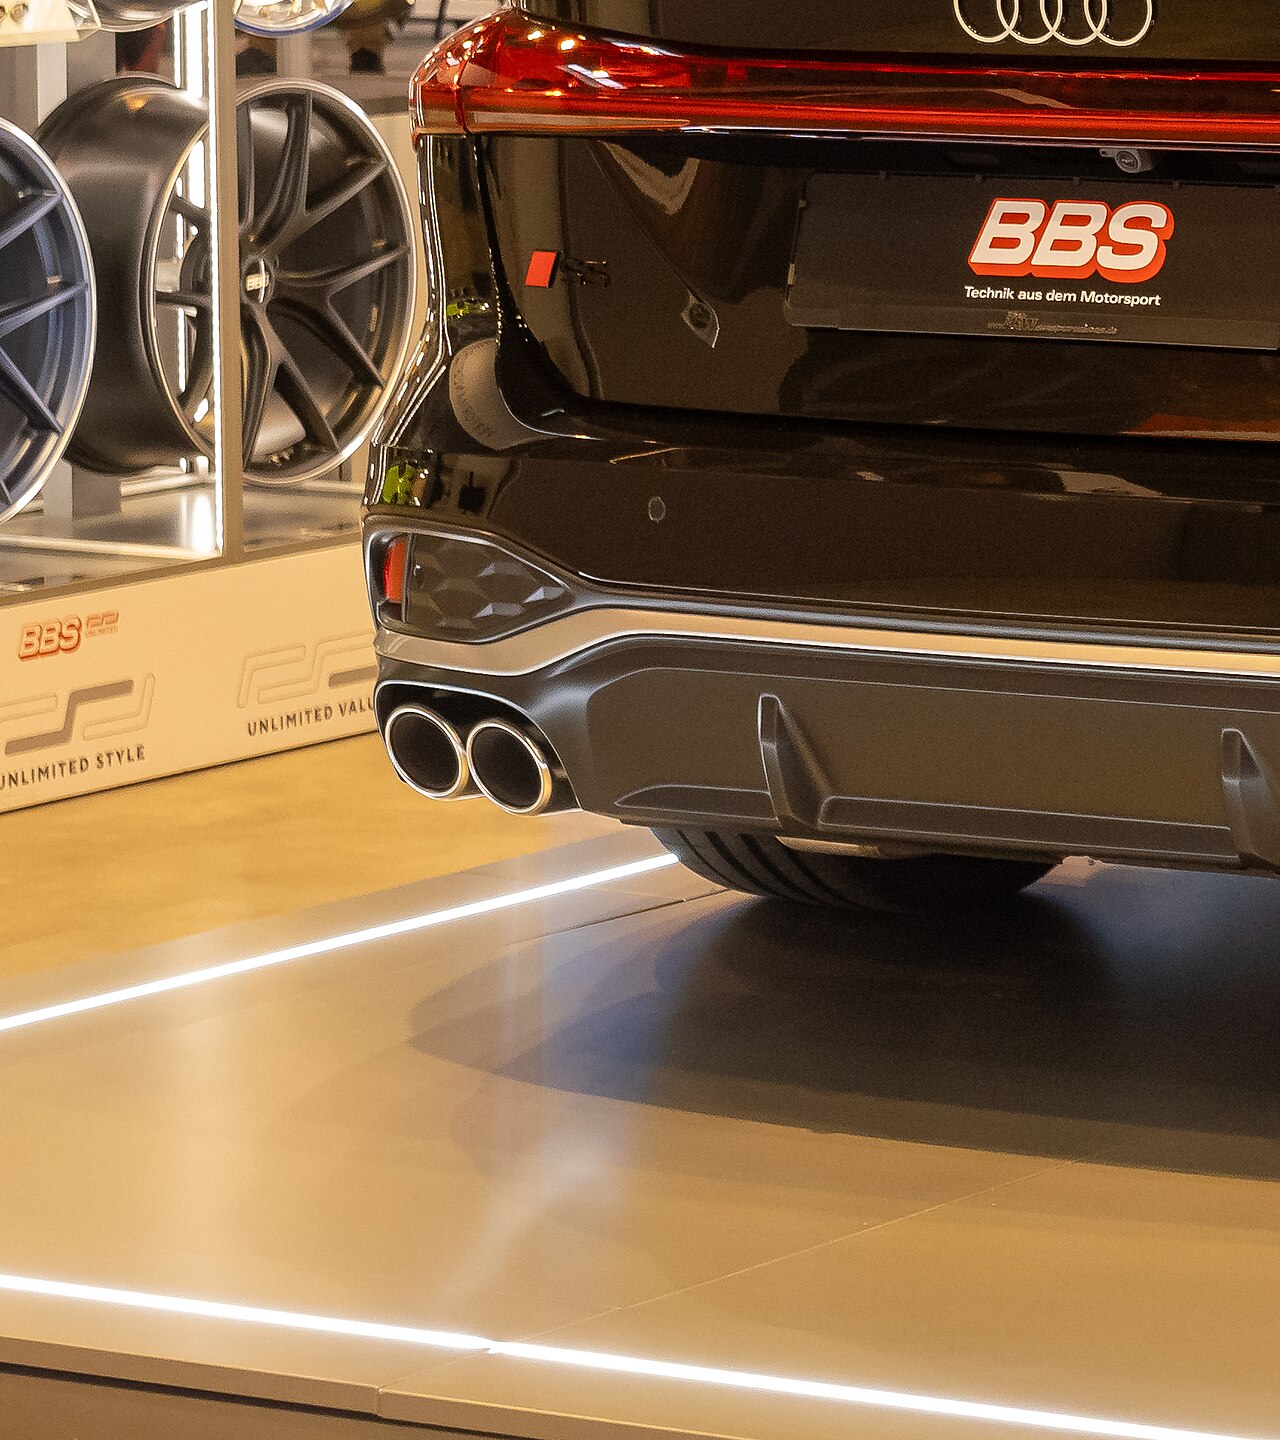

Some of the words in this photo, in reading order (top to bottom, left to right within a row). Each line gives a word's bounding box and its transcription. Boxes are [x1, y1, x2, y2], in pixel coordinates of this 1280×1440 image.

[968, 197, 1175, 284] BBS
[964, 285, 1014, 300] Technik
[1018, 290, 1043, 301] aus
[1046, 289, 1077, 302] dem
[1080, 290, 1161, 307] Motorsport
[18, 614, 82, 662] BBS
[248, 705, 333, 737] UNLIMITED
[0, 756, 89, 791] UNLIMITED
[96, 743, 146, 770] STYLE
